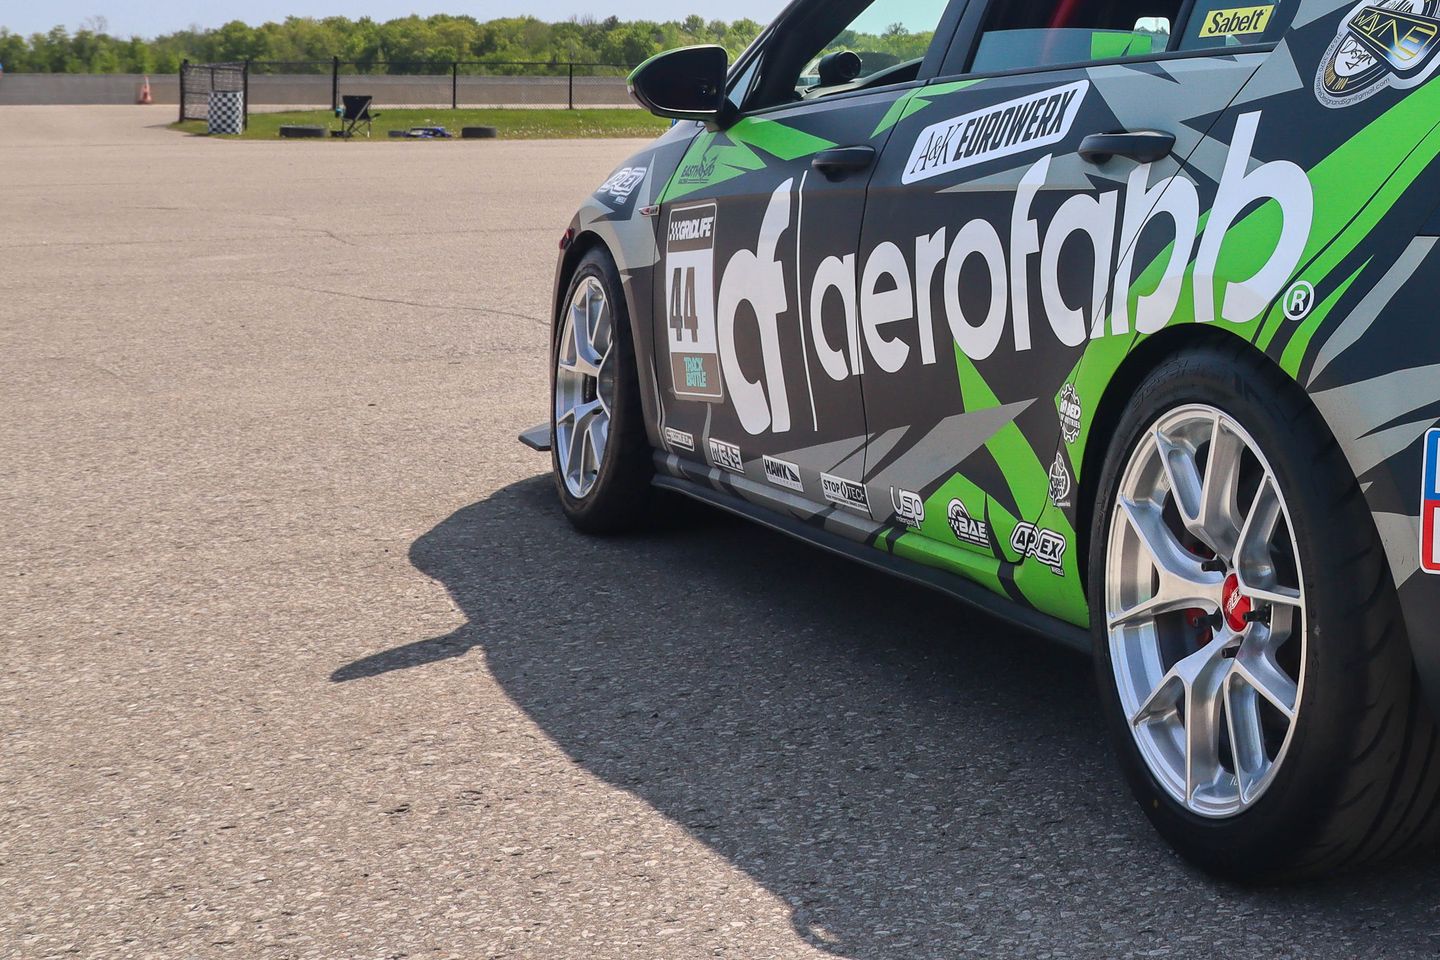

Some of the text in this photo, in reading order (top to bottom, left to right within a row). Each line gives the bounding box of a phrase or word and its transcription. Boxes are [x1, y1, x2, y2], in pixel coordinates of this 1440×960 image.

[1208, 9, 1264, 34] Sabelt
[910, 88, 1078, 175] A&K EUROWERX
[811, 110, 1314, 381] aerofabb
[670, 267, 698, 343] 44
[764, 458, 790, 481] HAWK
[1015, 529, 1061, 560] APEX
